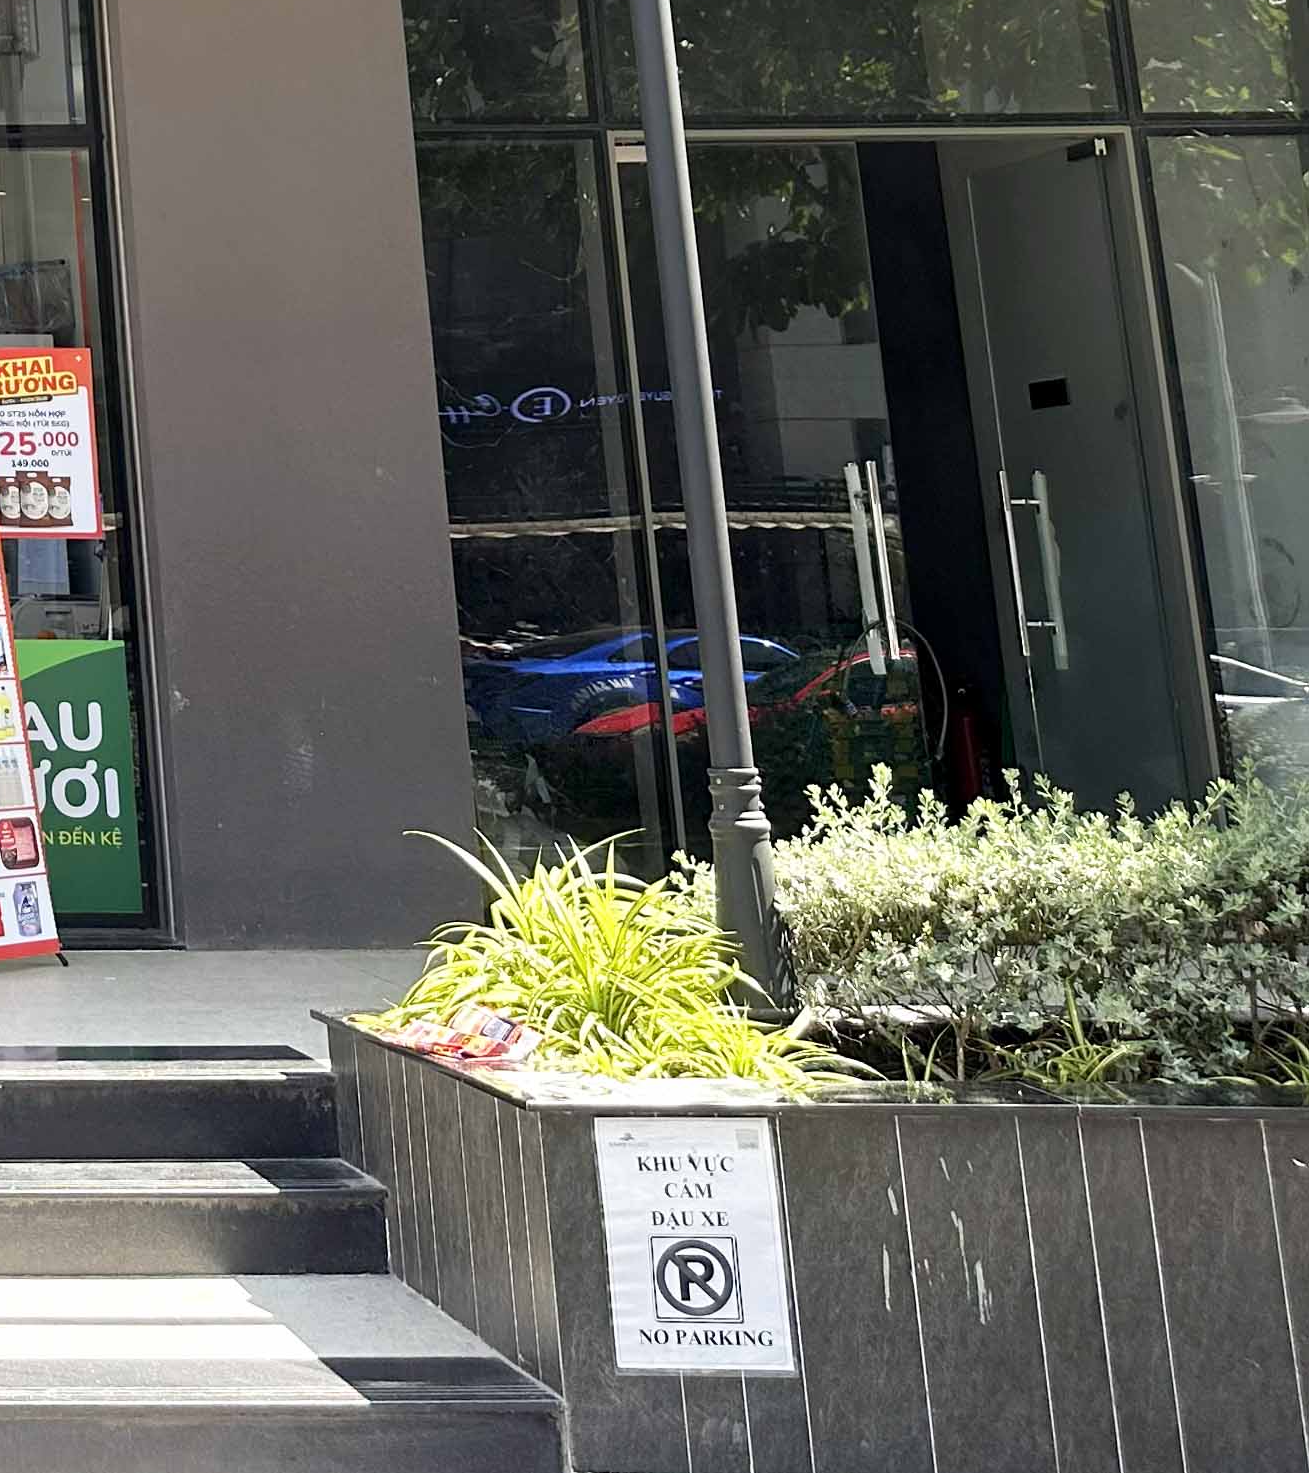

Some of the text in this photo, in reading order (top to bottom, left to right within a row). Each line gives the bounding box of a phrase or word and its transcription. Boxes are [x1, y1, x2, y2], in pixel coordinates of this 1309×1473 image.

[23, 701, 103, 752] AU
[58, 826, 95, 846] ĐẾN
[100, 827, 123, 848] KỆ
[637, 1155, 681, 1173] KHU
[701, 1211, 730, 1227] XE
[639, 1329, 774, 1347] NO PARKING
